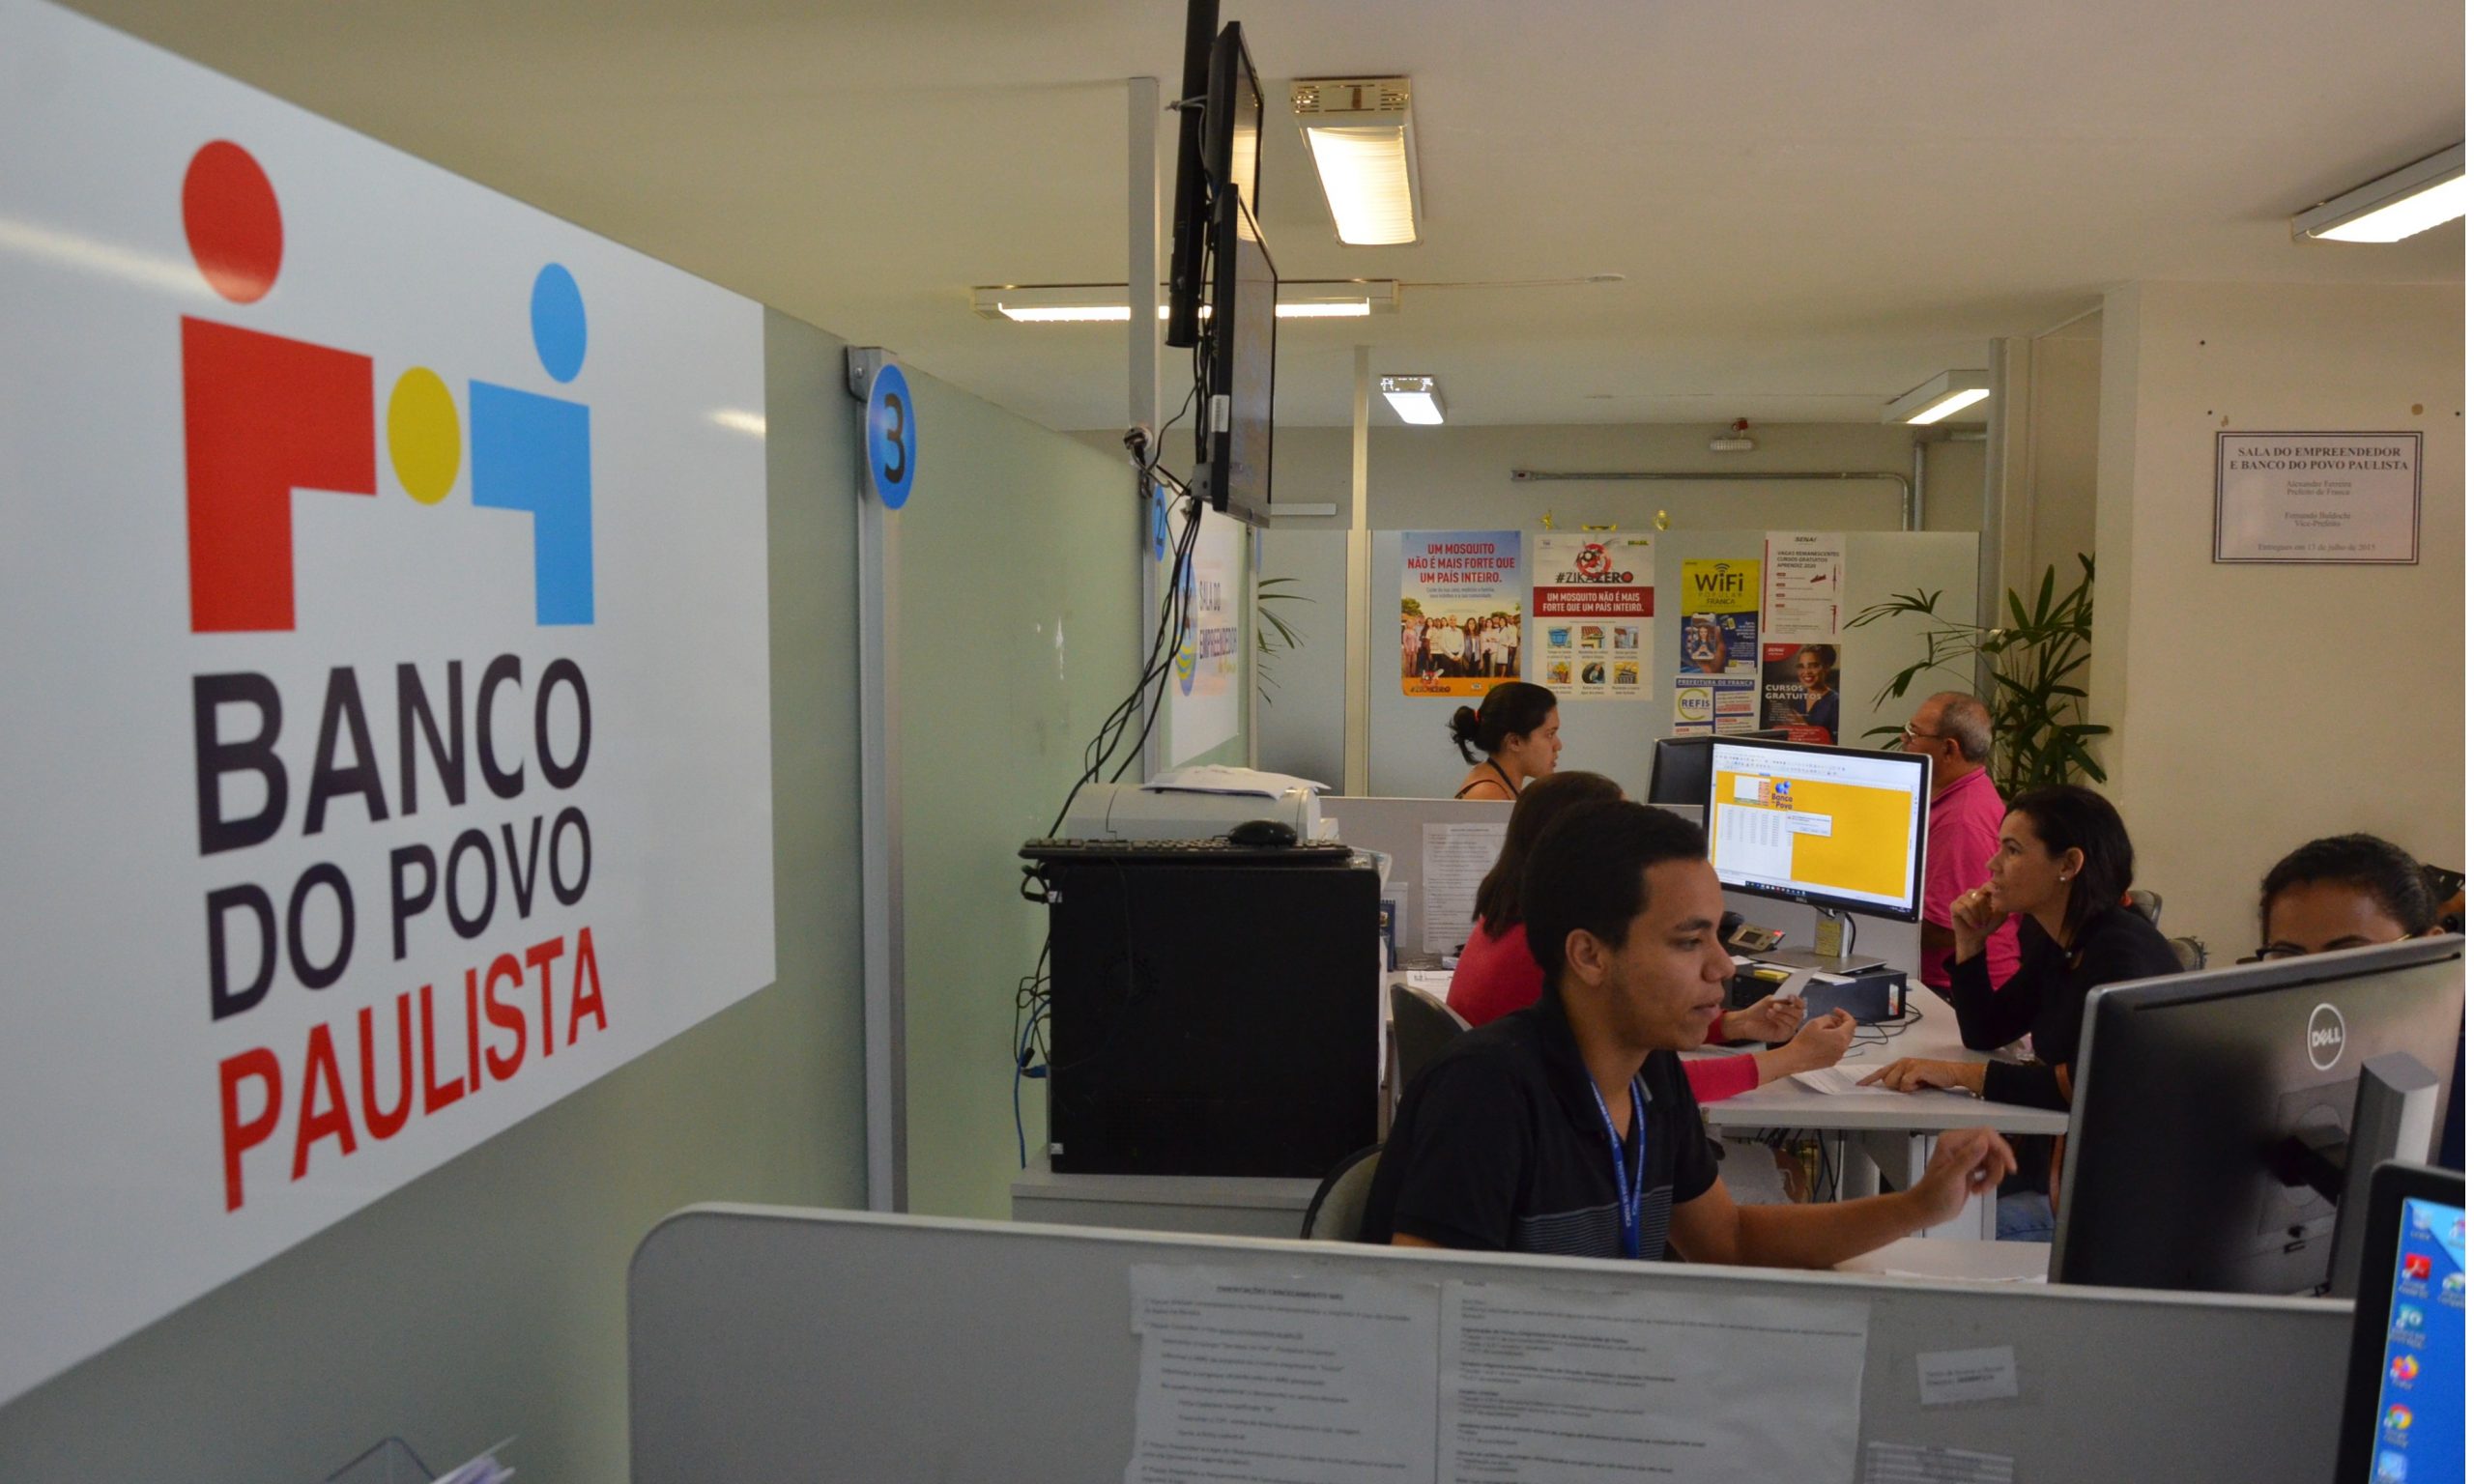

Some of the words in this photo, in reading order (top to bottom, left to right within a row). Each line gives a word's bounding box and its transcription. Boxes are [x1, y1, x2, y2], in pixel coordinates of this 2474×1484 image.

[884, 392, 906, 485] 3
[2238, 446, 2270, 457] SALA
[2273, 446, 2292, 457] DO
[2294, 446, 2402, 457] EMPREENDEDOR
[2229, 460, 2238, 471] E
[2241, 460, 2285, 471] BANCO
[2287, 460, 2307, 471] DO
[2310, 460, 2345, 471] POVO
[2347, 460, 2409, 471] PAULISTA
[1427, 543, 1443, 555] UM
[1445, 543, 1495, 555] MOSQUITO
[1407, 556, 1428, 569] NÃO
[1430, 556, 1436, 569] É
[1437, 557, 1463, 569] MAIS
[1464, 556, 1494, 569] FORTE
[1495, 556, 1515, 569] QUE
[1420, 572, 1435, 584] UM
[1437, 570, 1459, 584] PAÍS
[1461, 572, 1503, 584] INTEIRO.
[1555, 571, 1634, 585] #ZIKAZERO
[1694, 572, 1744, 592] WiFi
[1547, 592, 1559, 602] UM
[1560, 592, 1597, 602] MOSQUITO
[1598, 591, 1614, 602] NÃO
[1615, 591, 1620, 602] É
[1622, 592, 1640, 602] MAIS
[1542, 603, 1566, 612] FORTE
[1566, 603, 1581, 612] QUE
[1582, 603, 1594, 612] UM
[1595, 602, 1612, 612] PAÍS
[1613, 603, 1644, 612] INTEIRO.
[1765, 692, 1822, 700] GRATUITOS
[190, 652, 593, 858] BANCO
[206, 861, 356, 1024] DO
[389, 806, 592, 962] POVO
[2311, 1026, 2342, 1048] DELL
[218, 926, 608, 1214] PAULISTA
